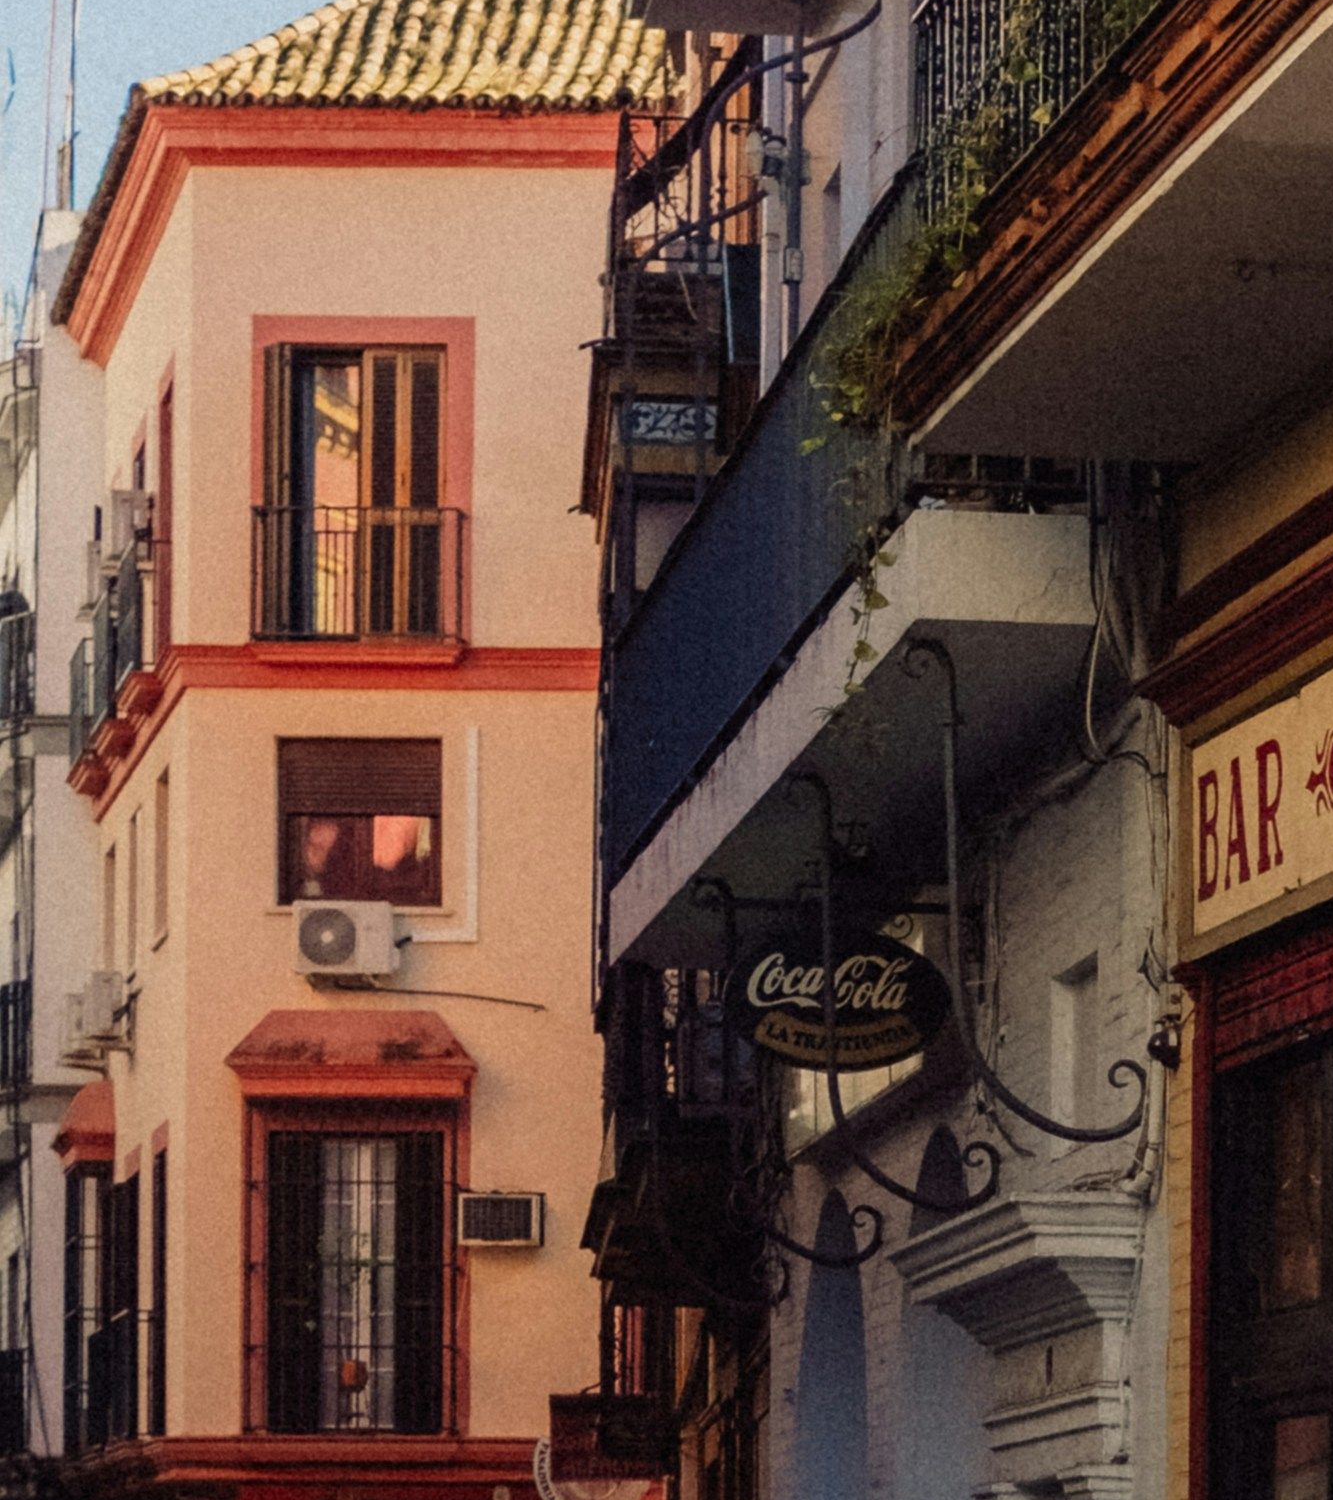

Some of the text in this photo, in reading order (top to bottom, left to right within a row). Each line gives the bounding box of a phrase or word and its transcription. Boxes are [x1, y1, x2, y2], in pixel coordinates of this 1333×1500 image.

[1197, 738, 1284, 903] BAR
[746, 952, 914, 1010] CocaCola
[766, 1022, 789, 1043] LA
